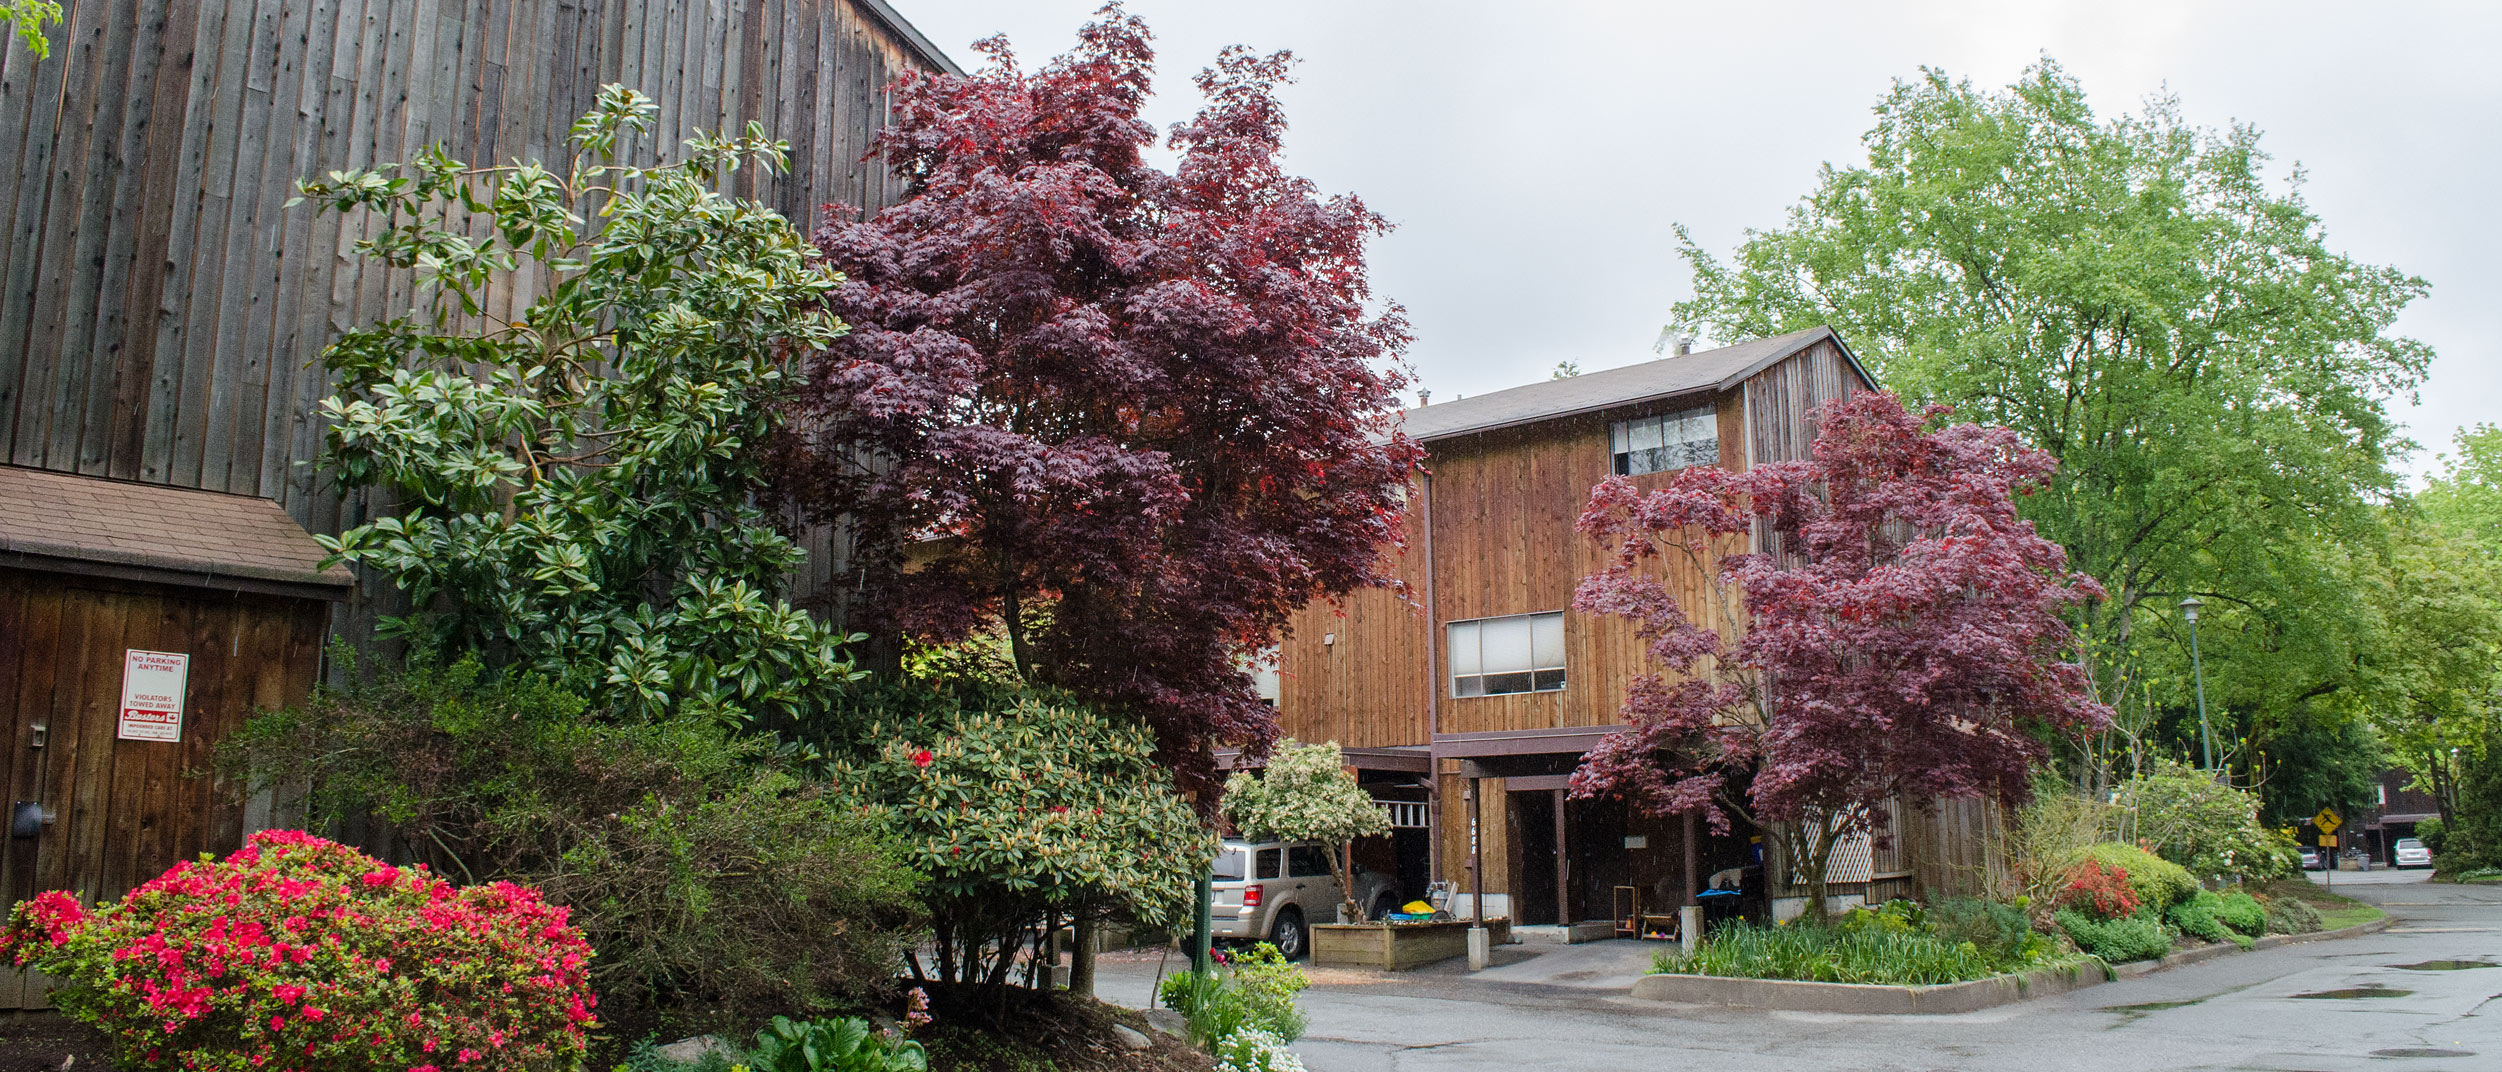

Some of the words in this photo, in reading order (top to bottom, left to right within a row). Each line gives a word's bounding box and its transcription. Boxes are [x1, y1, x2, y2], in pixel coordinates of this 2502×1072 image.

[146, 657, 181, 666] PARKING
[138, 664, 174, 672] ANYTIME
[134, 693, 172, 702] VIOLATORS
[125, 710, 166, 722] Busters
